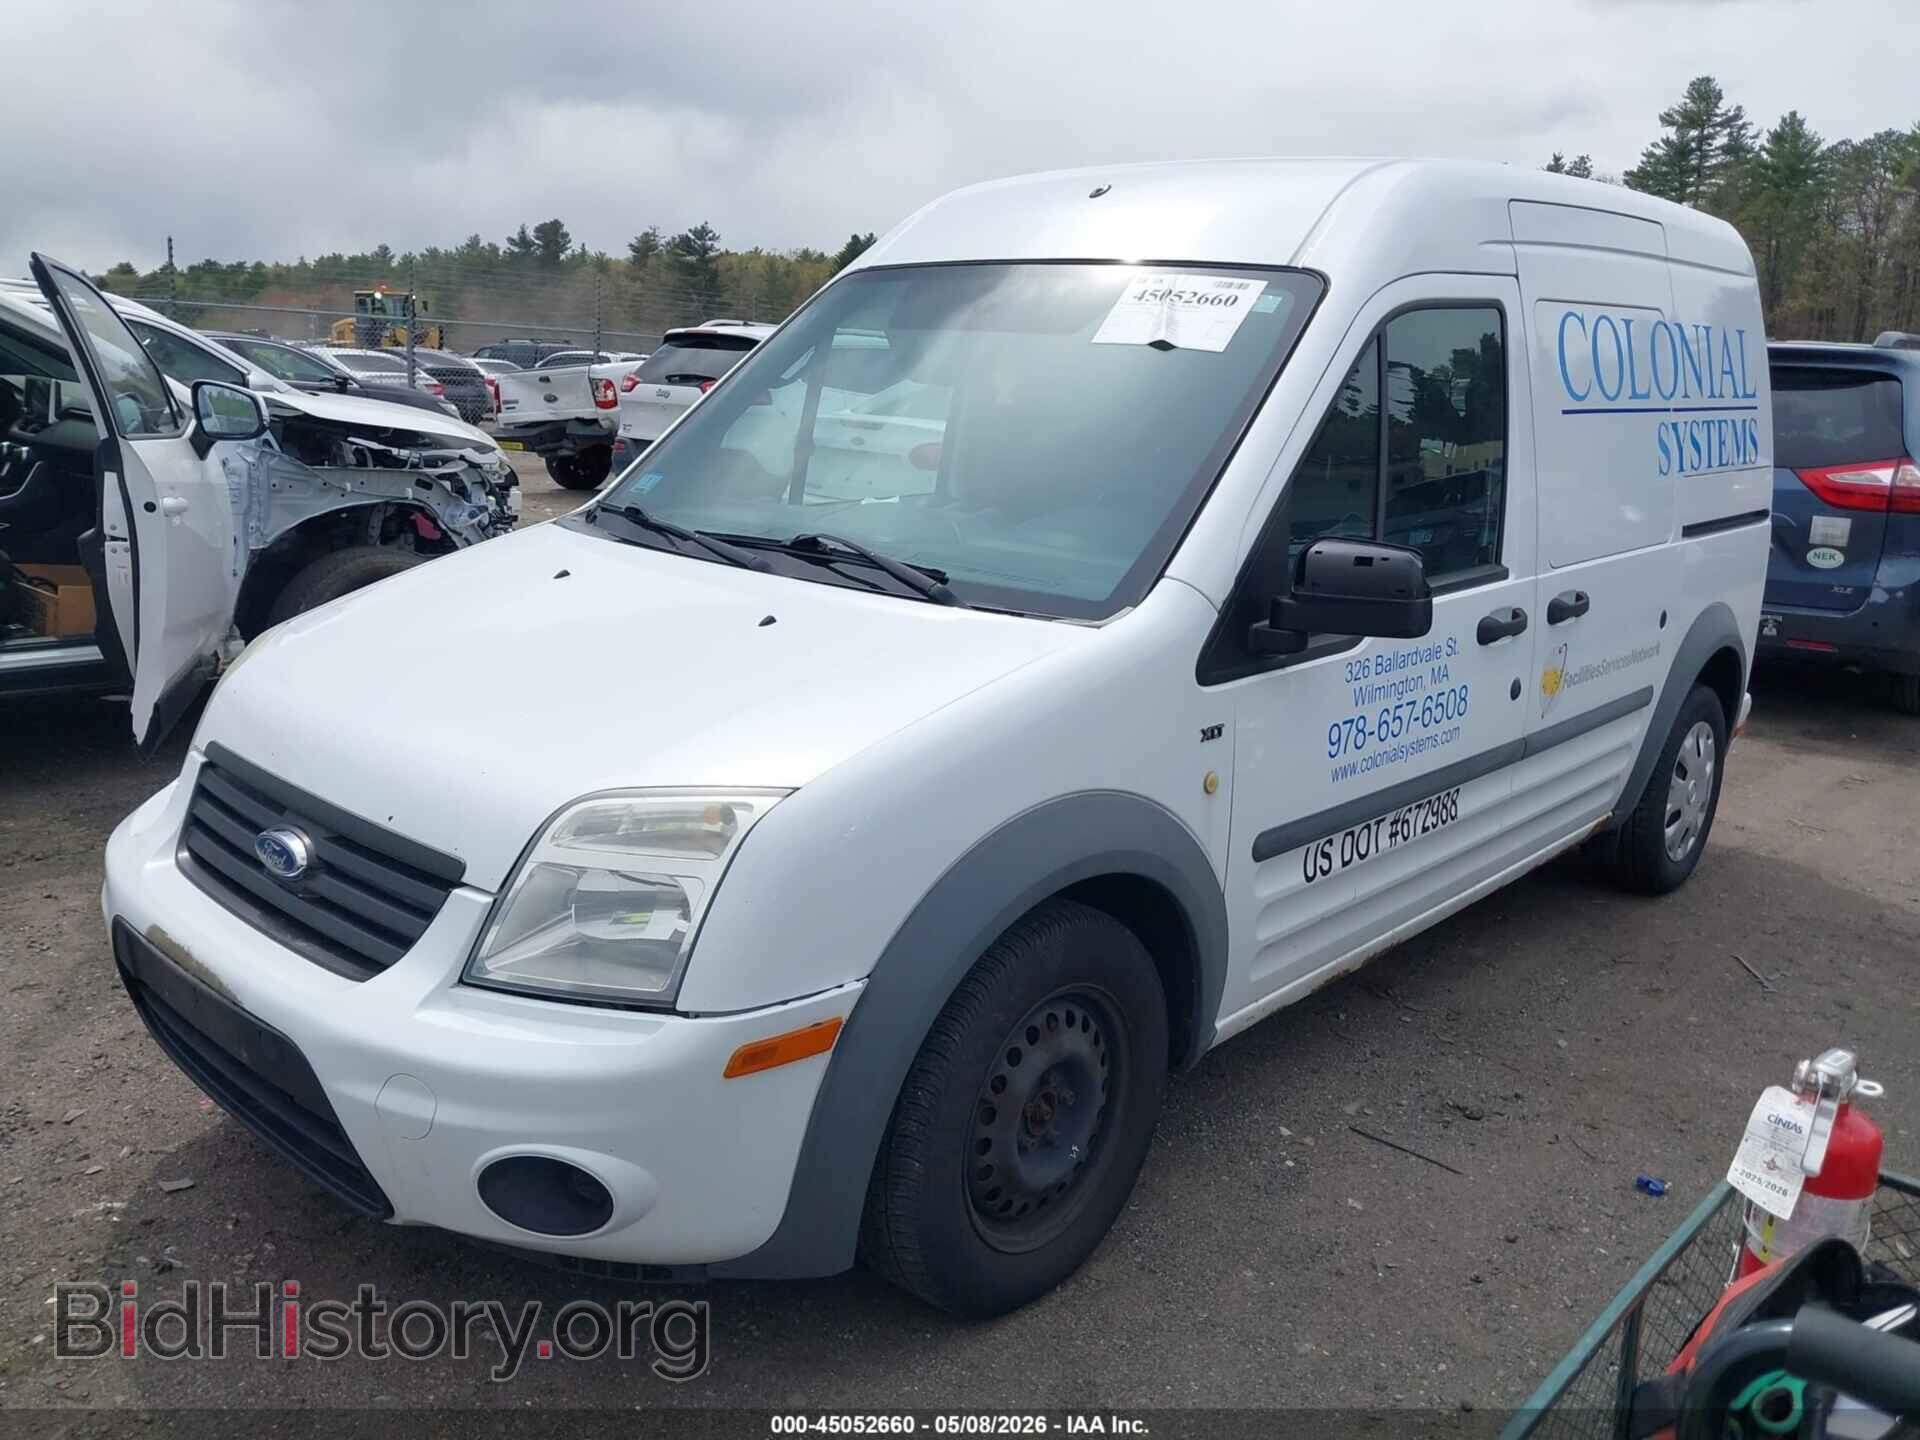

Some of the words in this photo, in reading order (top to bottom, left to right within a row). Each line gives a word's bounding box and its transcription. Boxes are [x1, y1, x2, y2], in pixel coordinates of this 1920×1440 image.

[1133, 288, 1239, 307] 45052660
[1557, 311, 1757, 402] COLONIAL
[1656, 417, 1759, 476] SYSTEMS
[1812, 551, 1837, 562] NEK
[1345, 659, 1371, 682] 326
[1374, 646, 1442, 676] Ballardvale
[1445, 637, 1460, 656] St.
[1353, 677, 1427, 707] Wilmington,
[1431, 665, 1450, 687] MA
[1327, 684, 1469, 760] 978-657-6508
[1331, 725, 1460, 784] www.colonialsystems.com
[1303, 837, 1334, 883] US
[1341, 818, 1386, 869] DOT
[1388, 788, 1460, 847] #672988
